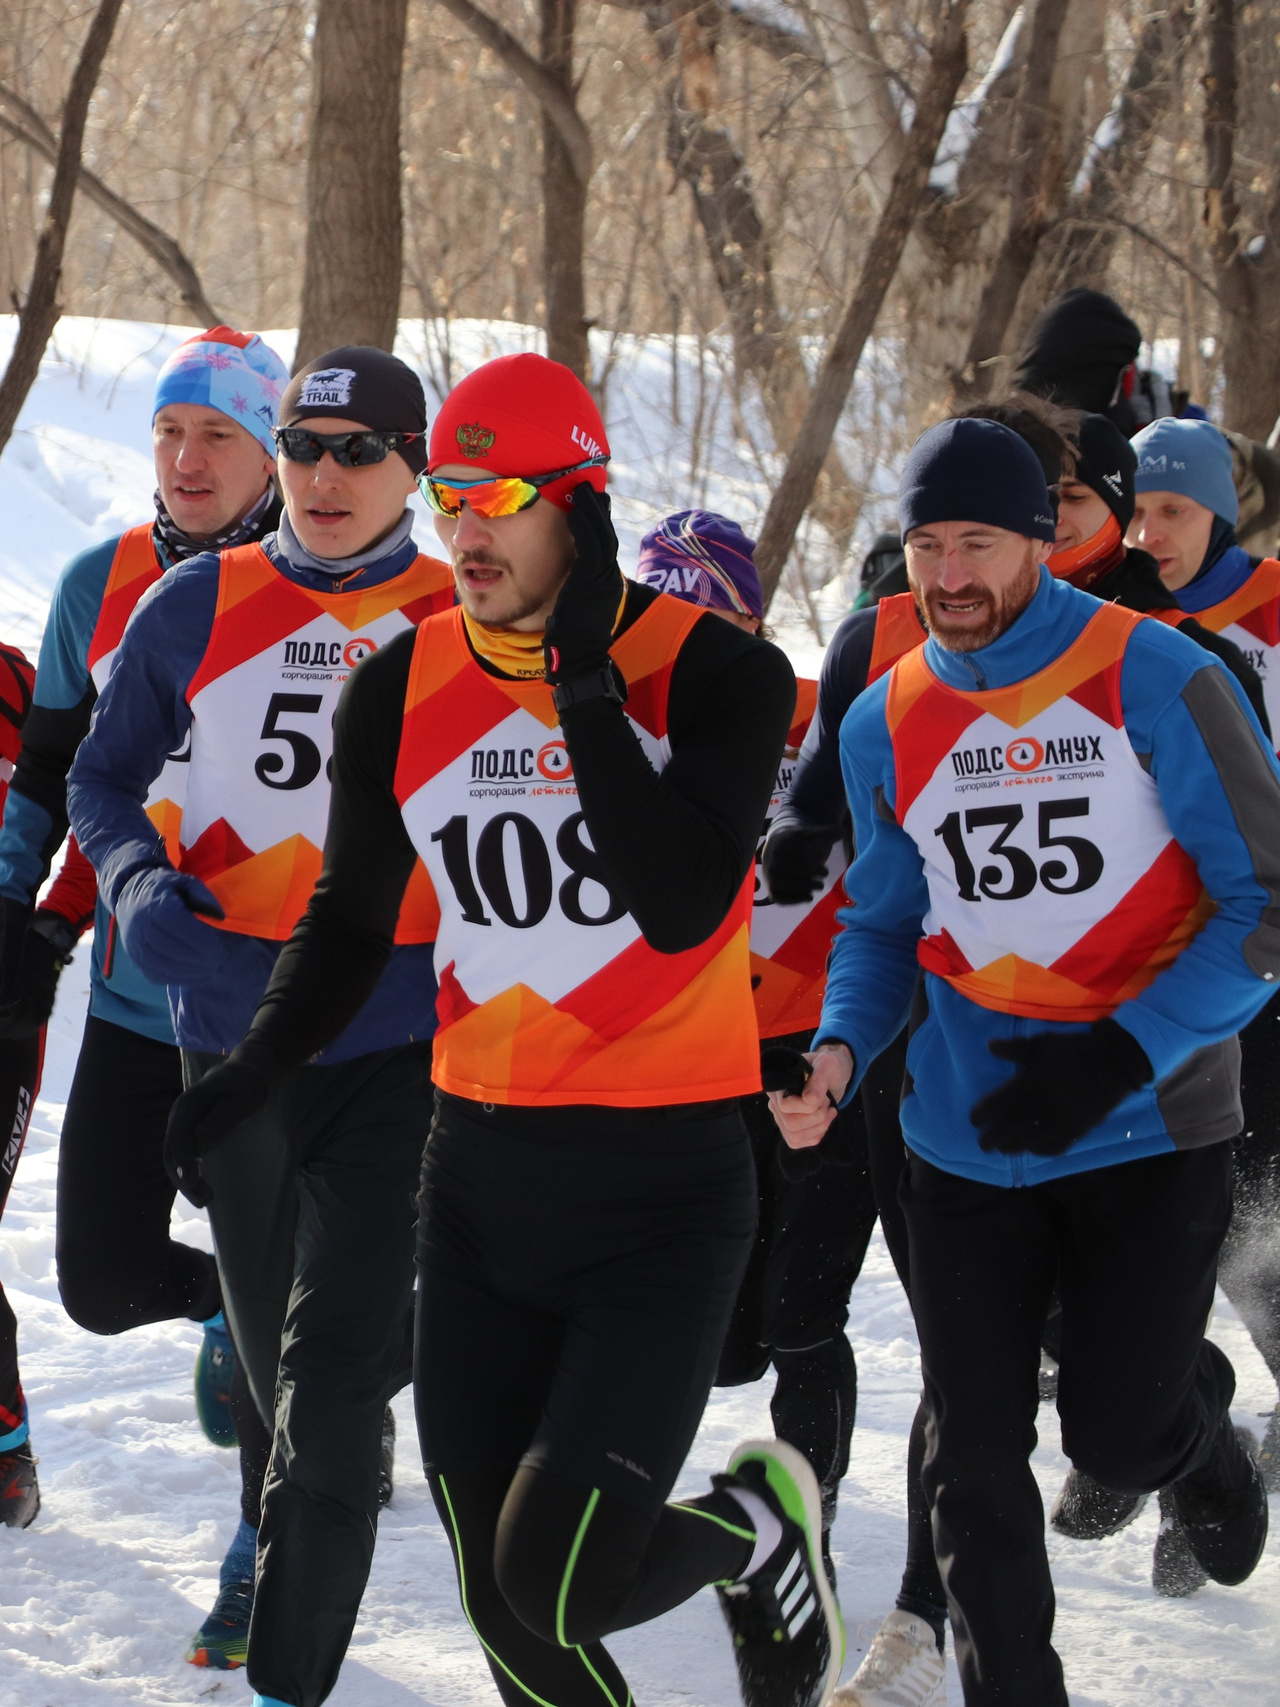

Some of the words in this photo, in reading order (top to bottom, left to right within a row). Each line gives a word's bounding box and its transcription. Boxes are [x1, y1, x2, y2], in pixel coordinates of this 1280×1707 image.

[306, 392, 341, 403] TRAIL
[571, 425, 604, 458] LUK
[1102, 474, 1124, 497] DEMIX
[284, 637, 380, 668] ПОДСО
[281, 671, 333, 682] корпорация
[255, 692, 337, 790] 5
[951, 735, 1106, 777] ПОДСОЛНУХ
[471, 740, 574, 781] ПОДСО
[469, 786, 526, 799] корпорация
[528, 785, 579, 797] летнег
[954, 779, 1000, 794] корпорация
[1002, 775, 1054, 789] летнего
[1056, 769, 1105, 782] экстрима
[934, 796, 1105, 902] 135
[430, 810, 629, 929] 108
